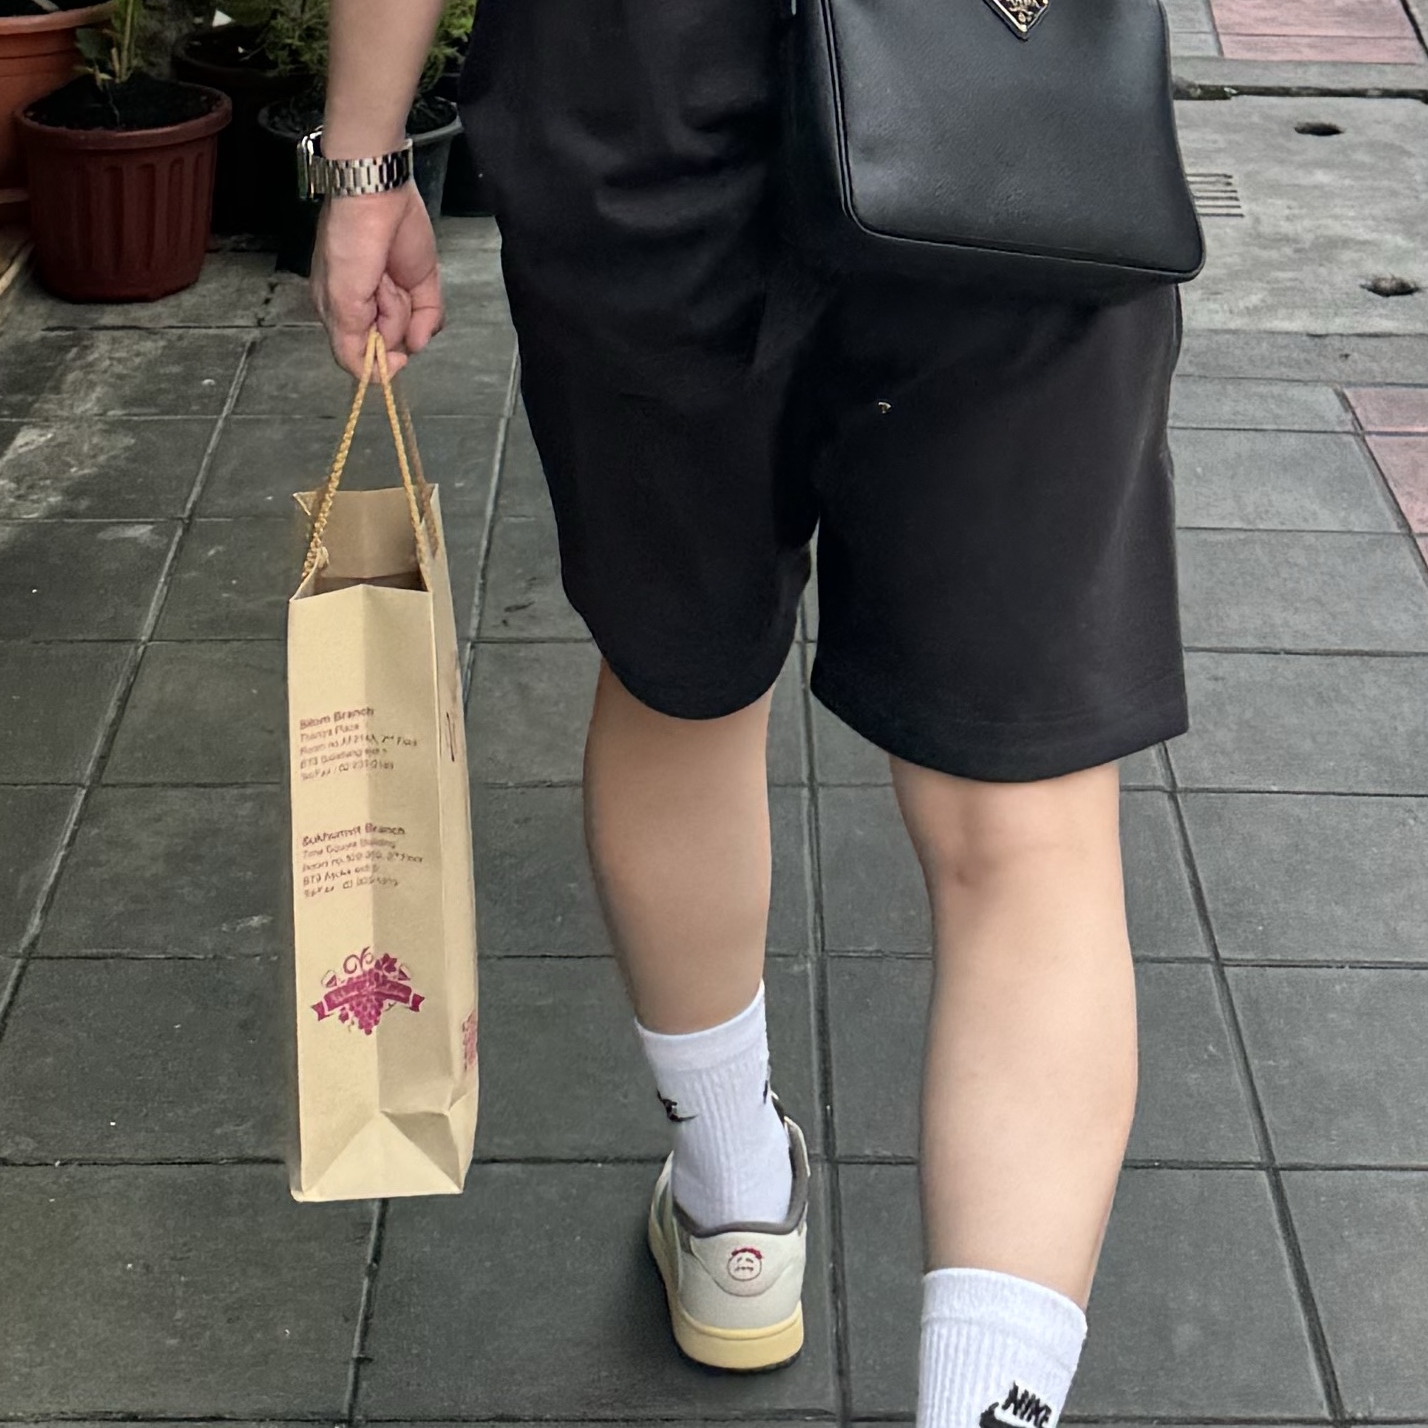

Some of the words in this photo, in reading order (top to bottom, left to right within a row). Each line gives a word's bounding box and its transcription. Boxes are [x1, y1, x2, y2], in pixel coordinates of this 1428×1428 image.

[333, 707, 374, 722] Branch
[365, 822, 406, 835] Branch
[1002, 1380, 1052, 1428] NIKE
